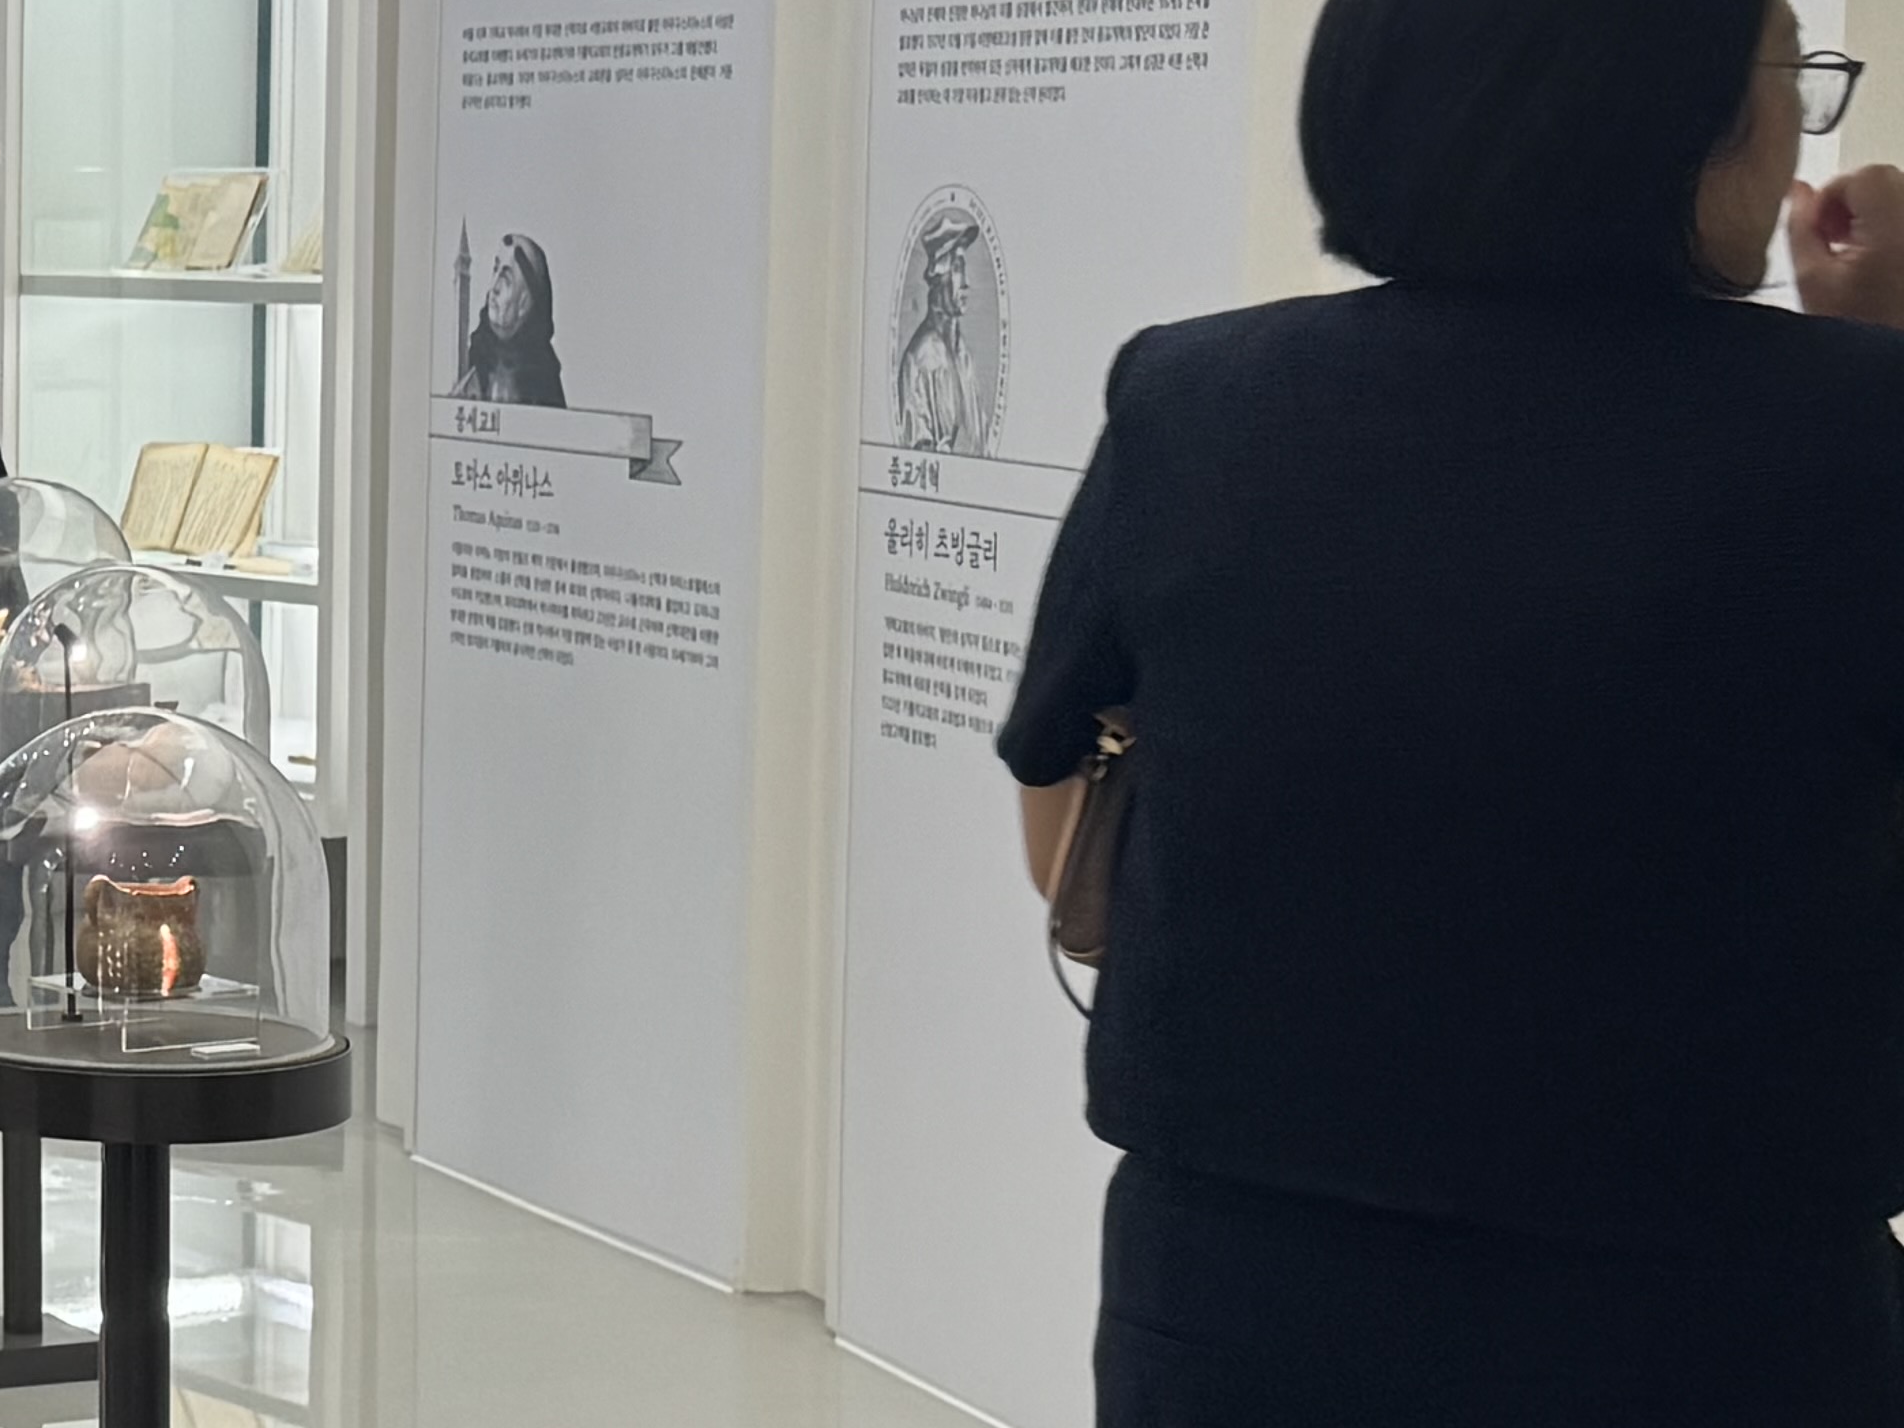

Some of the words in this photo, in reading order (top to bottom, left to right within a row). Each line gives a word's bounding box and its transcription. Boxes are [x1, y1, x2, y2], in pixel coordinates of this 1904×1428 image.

[451, 458, 493, 491] 토마스
[496, 462, 554, 498] 아퀴나스
[888, 455, 940, 492] 종교개혁
[884, 518, 930, 560] 울리히
[933, 526, 998, 572] 츠빙글리
